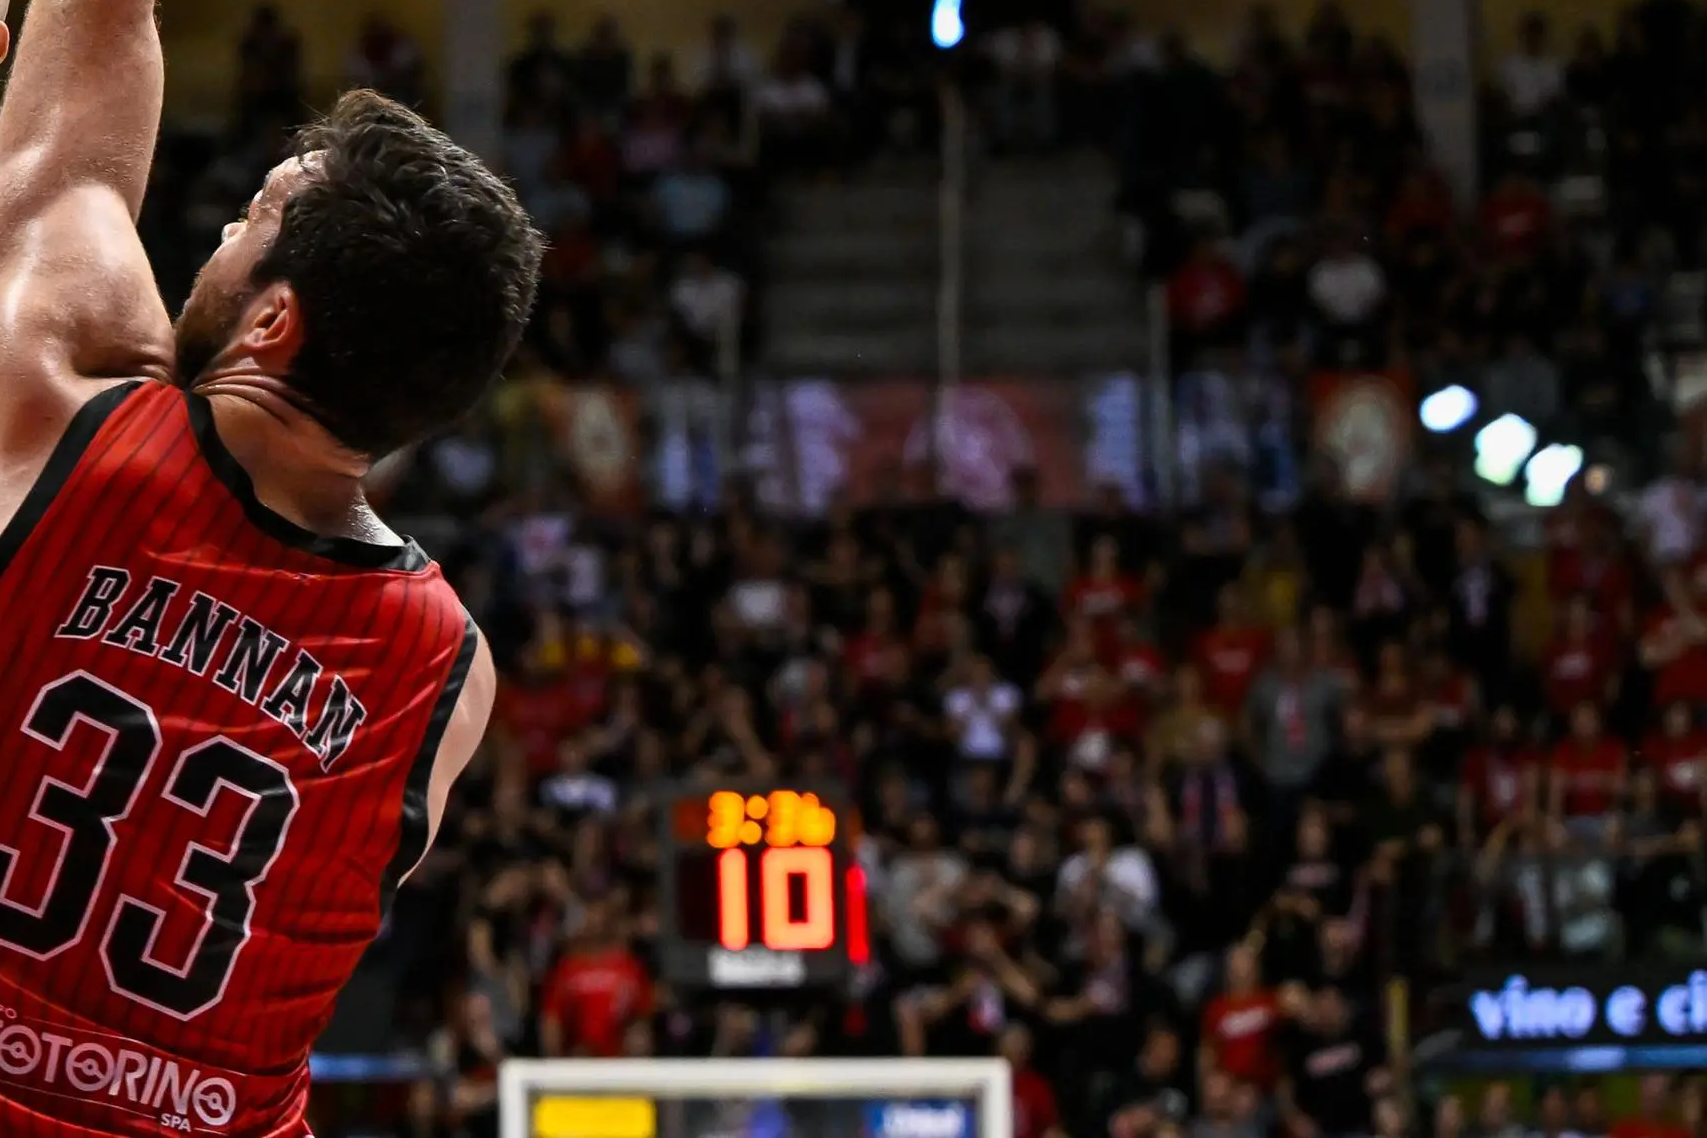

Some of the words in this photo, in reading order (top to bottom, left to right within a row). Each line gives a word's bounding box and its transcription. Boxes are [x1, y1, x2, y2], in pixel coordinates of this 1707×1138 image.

[54, 564, 368, 774] BANNAN
[719, 847, 835, 951] 10
[1469, 974, 1596, 1039] vino
[1605, 985, 1646, 1036] e
[160, 1112, 191, 1132] SPA
